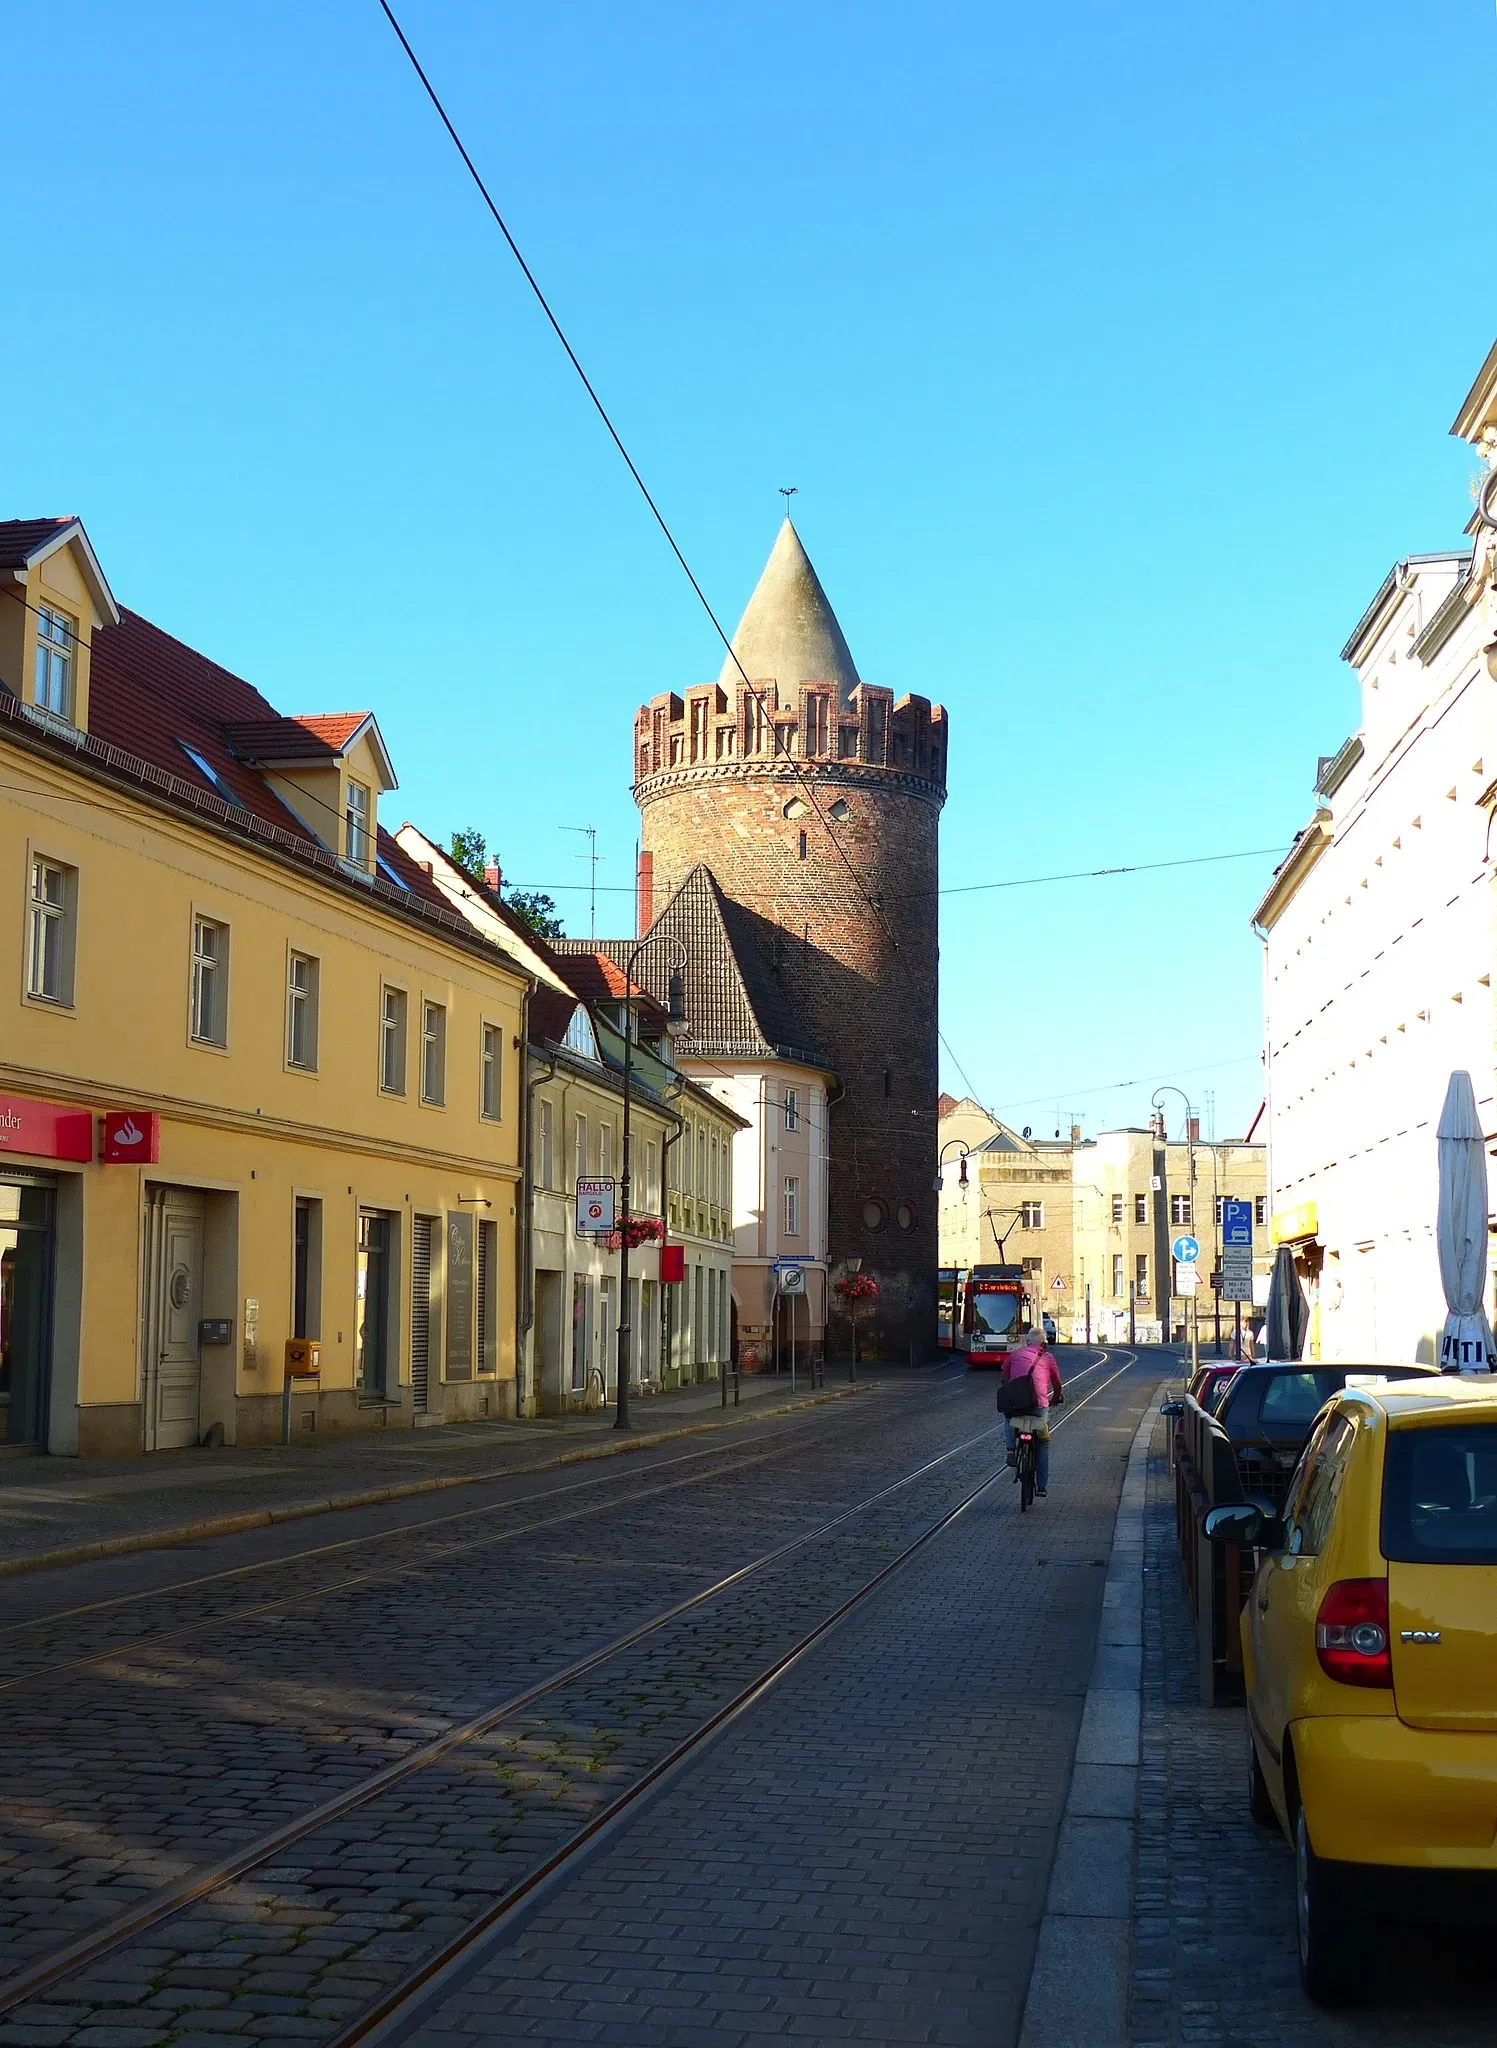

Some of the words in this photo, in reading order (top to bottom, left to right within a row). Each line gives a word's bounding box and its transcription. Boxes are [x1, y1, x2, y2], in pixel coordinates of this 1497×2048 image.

[579, 1183, 612, 1191] HALLO
[1227, 1204, 1240, 1221] P
[1400, 1631, 1441, 1644] FOX
